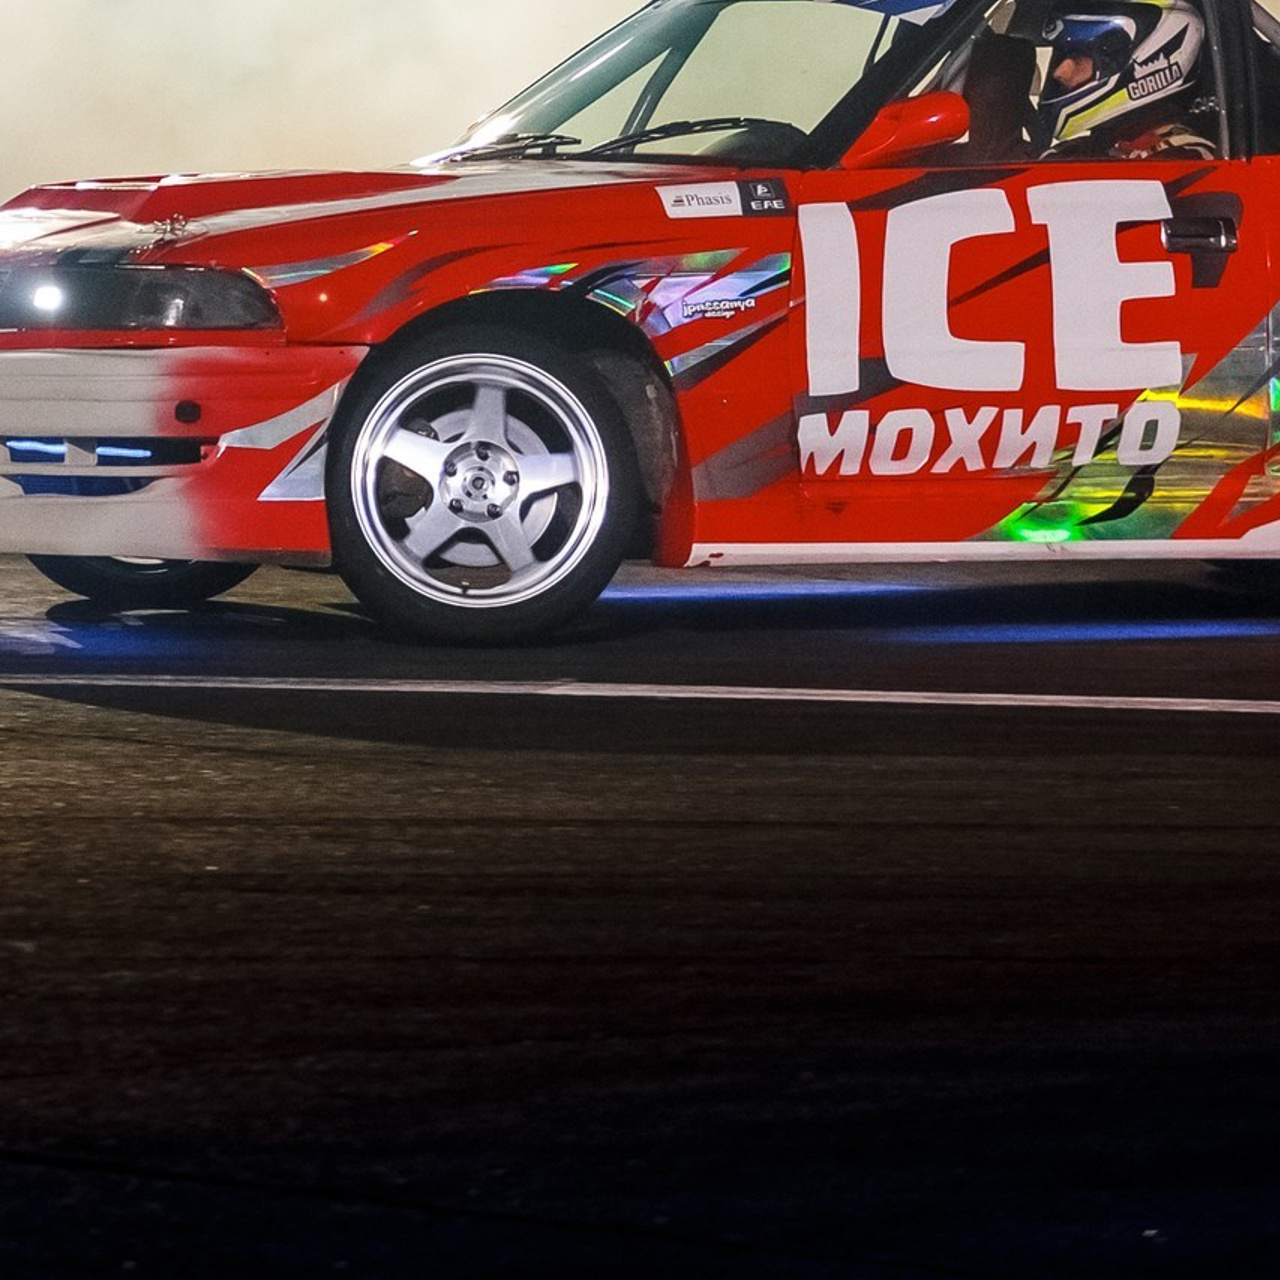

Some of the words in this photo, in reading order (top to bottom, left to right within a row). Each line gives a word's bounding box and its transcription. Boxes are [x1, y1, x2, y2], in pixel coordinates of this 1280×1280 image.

[1128, 65, 1182, 99] GORILLA
[685, 191, 733, 207] Phasis
[798, 180, 1183, 397] ICE
[798, 400, 1182, 476] МОХИТО
